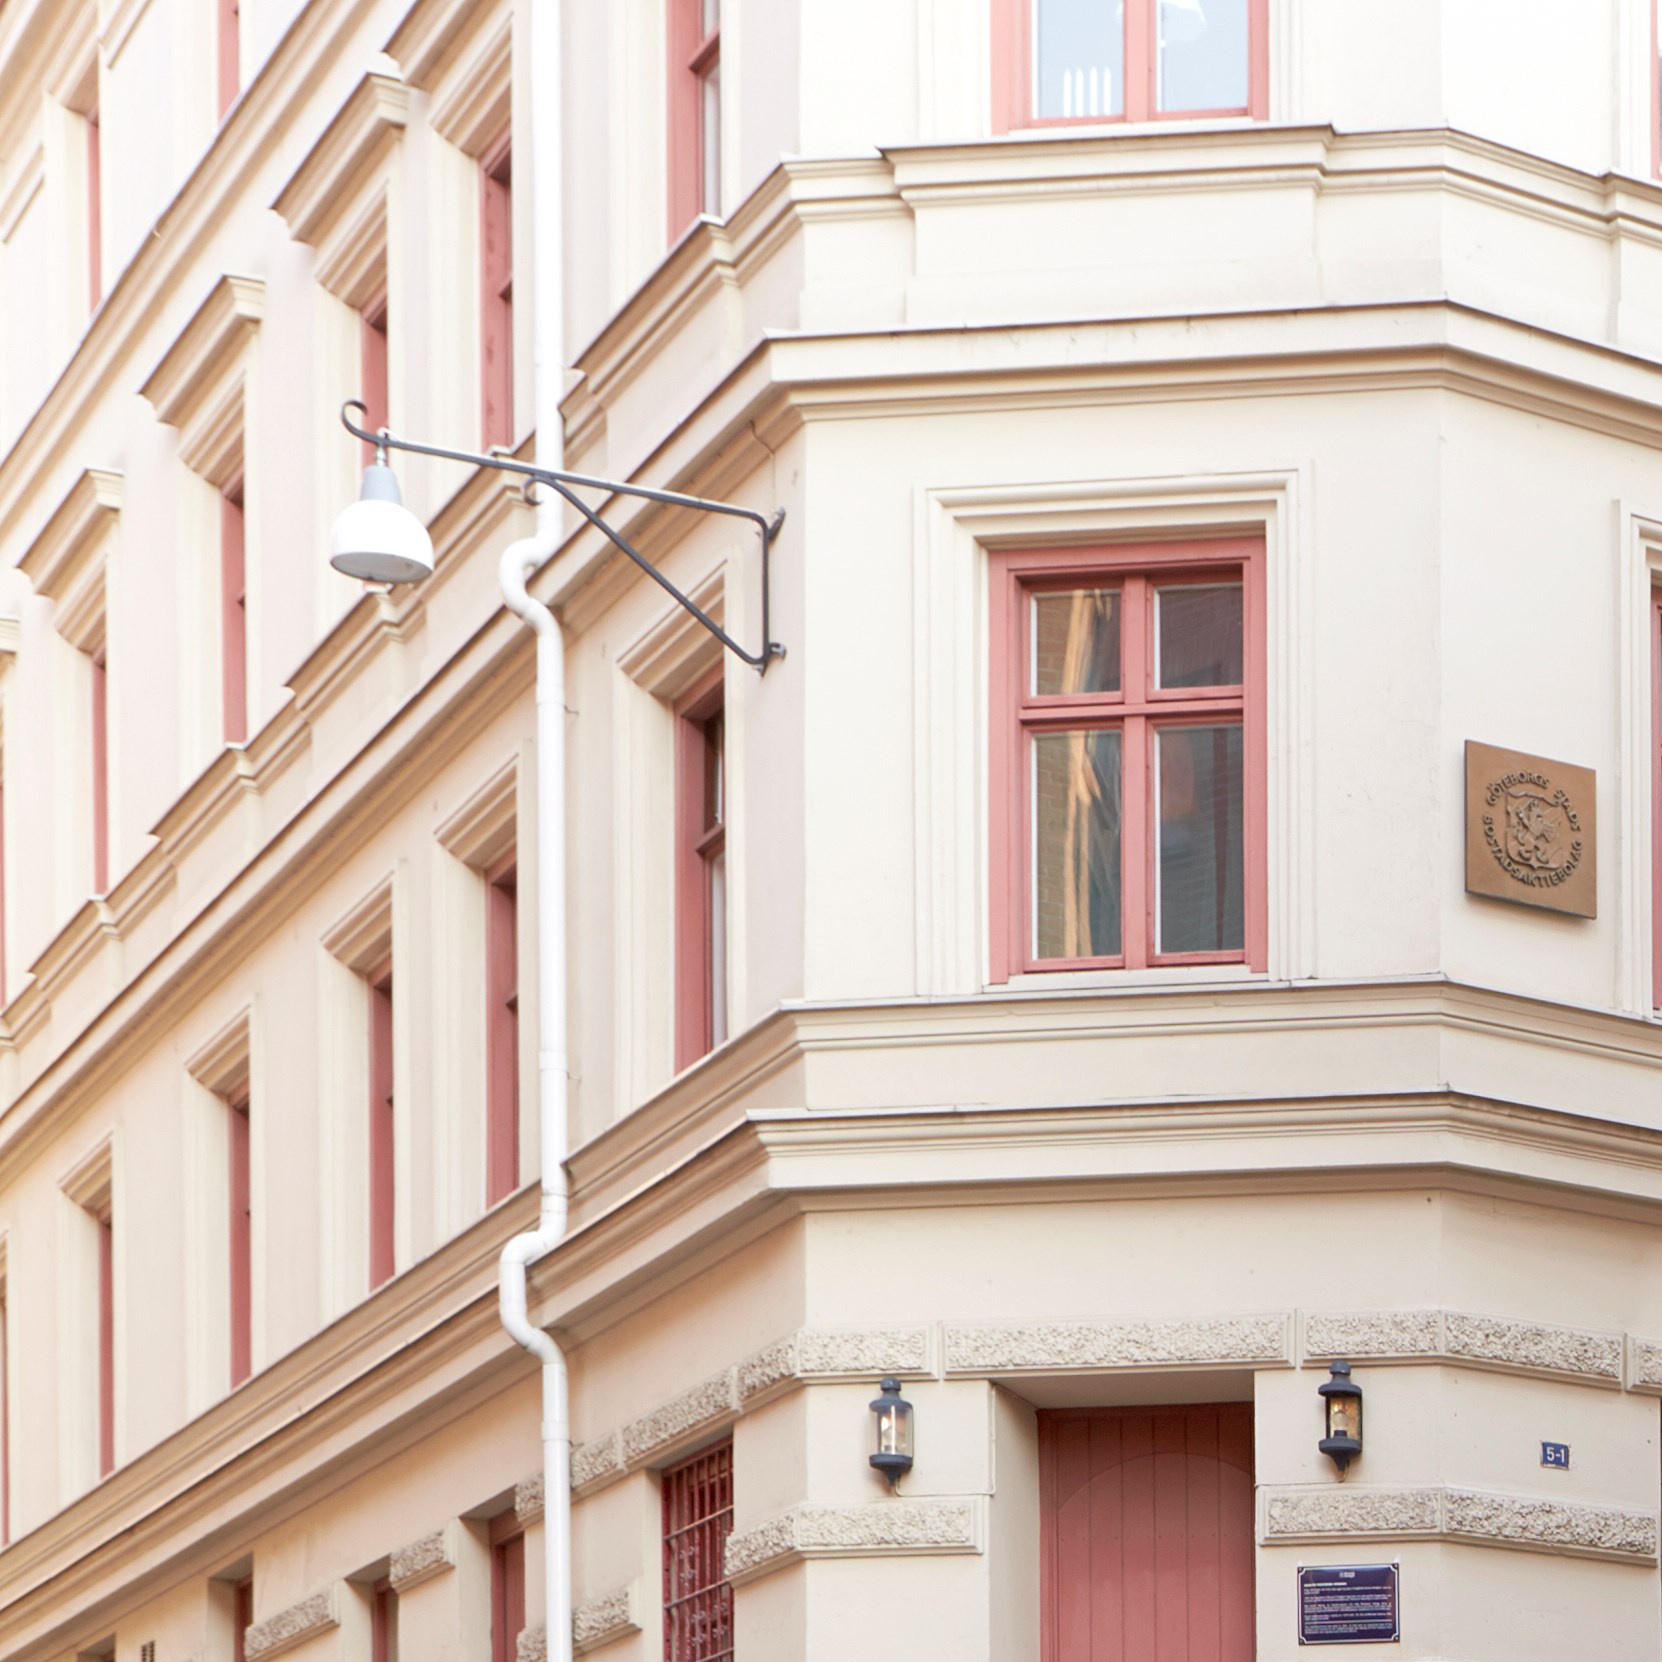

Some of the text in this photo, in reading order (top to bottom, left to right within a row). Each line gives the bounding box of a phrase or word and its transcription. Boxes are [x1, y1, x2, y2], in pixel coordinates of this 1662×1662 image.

[1486, 769, 1582, 833] GÖTEBORGS STADS
[1546, 1446, 1565, 1463] 5-1
